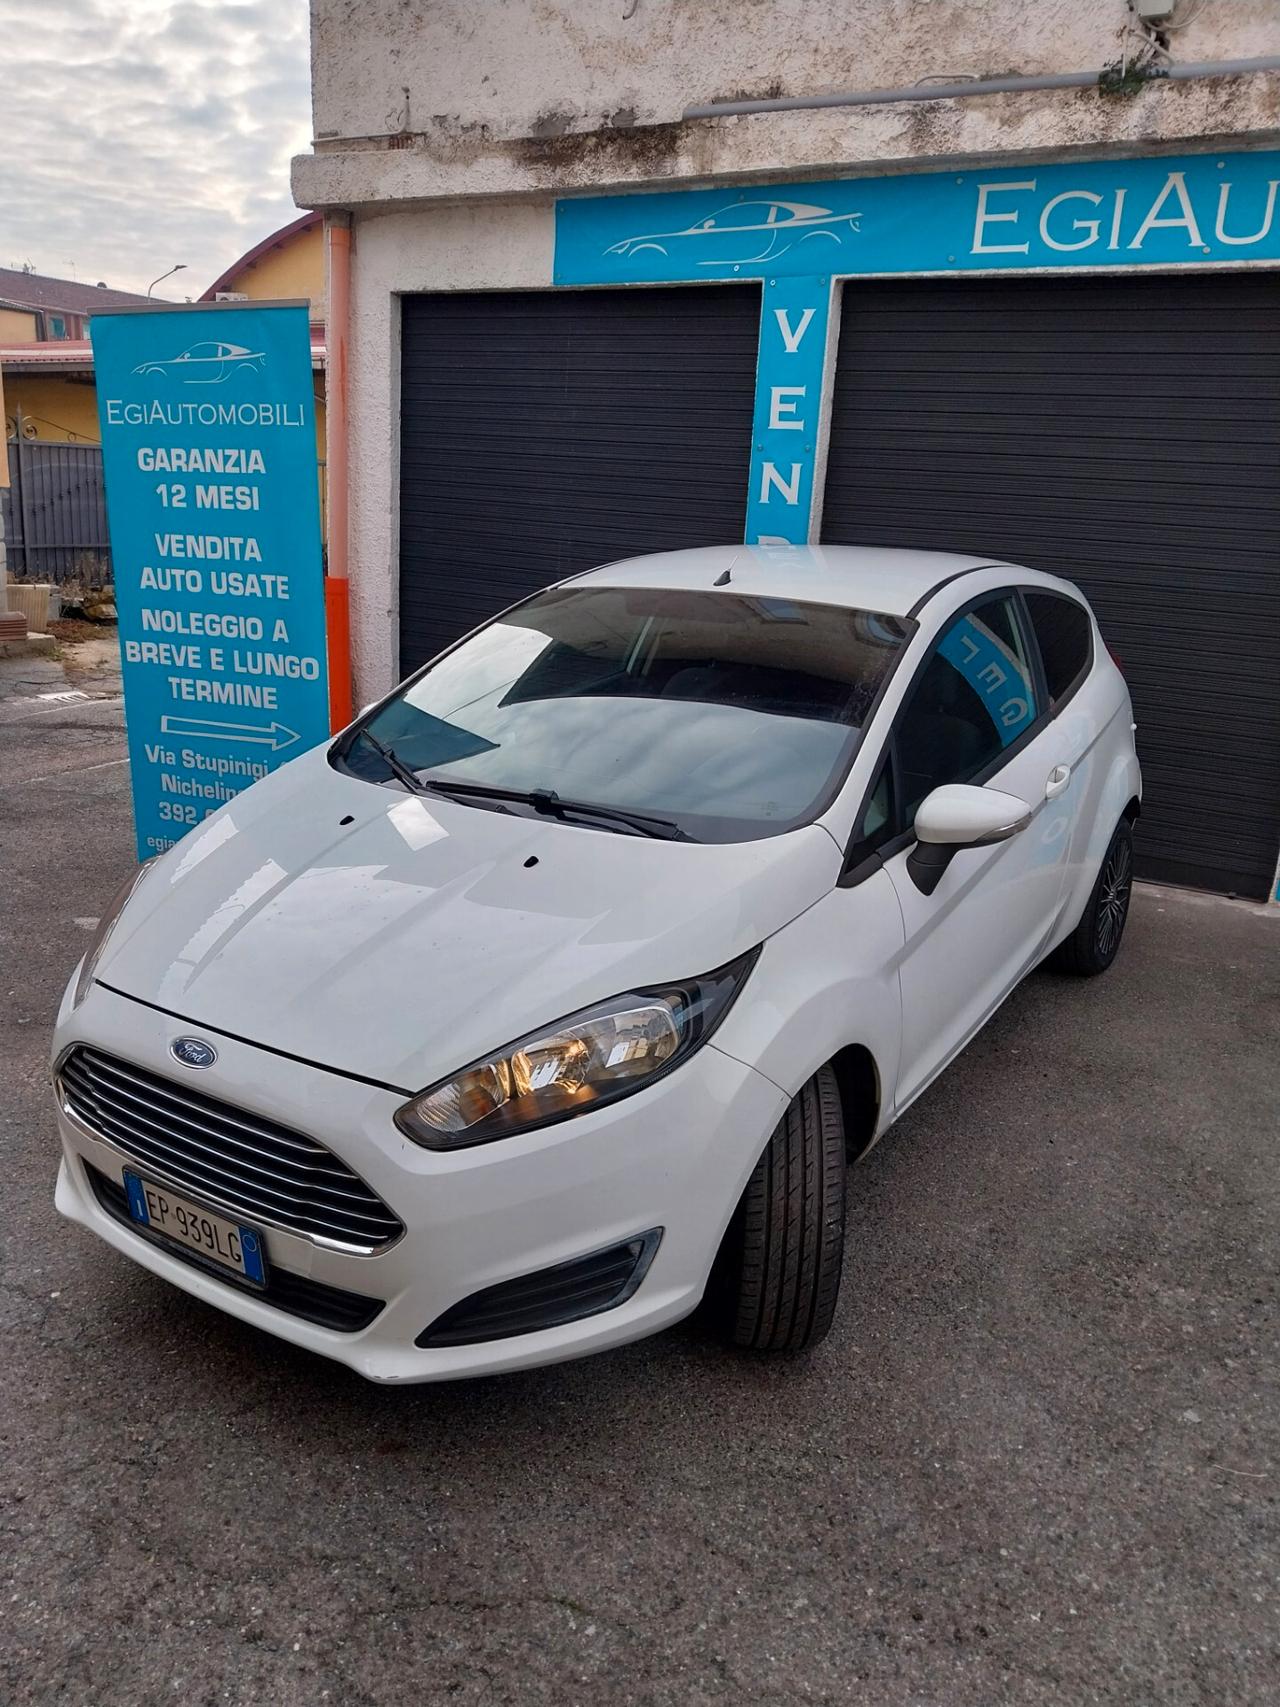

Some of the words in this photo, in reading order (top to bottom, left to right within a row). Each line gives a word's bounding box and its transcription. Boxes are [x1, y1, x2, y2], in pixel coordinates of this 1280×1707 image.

[757, 308, 817, 545] VEN
[137, 447, 267, 474] GARANZIA
[156, 483, 187, 508] 12
[195, 484, 260, 511] MESI
[155, 533, 262, 562] VENDITA
[140, 567, 203, 593] AUTO
[211, 571, 290, 600] USATE
[141, 608, 263, 641] NOLEGGIO
[272, 619, 290, 644] A
[125, 640, 202, 669] BREVE
[210, 648, 225, 671] E
[233, 650, 320, 681] LUNGO
[168, 676, 278, 710] TERMINE
[144, 743, 176, 766] Via
[181, 749, 269, 782] Stupinigi
[161, 773, 243, 801] Nichelin
[158, 801, 198, 825] 392
[178, 1042, 207, 1063] Ford
[145, 1190, 169, 1225] EP
[175, 1206, 242, 1263] 939LG
